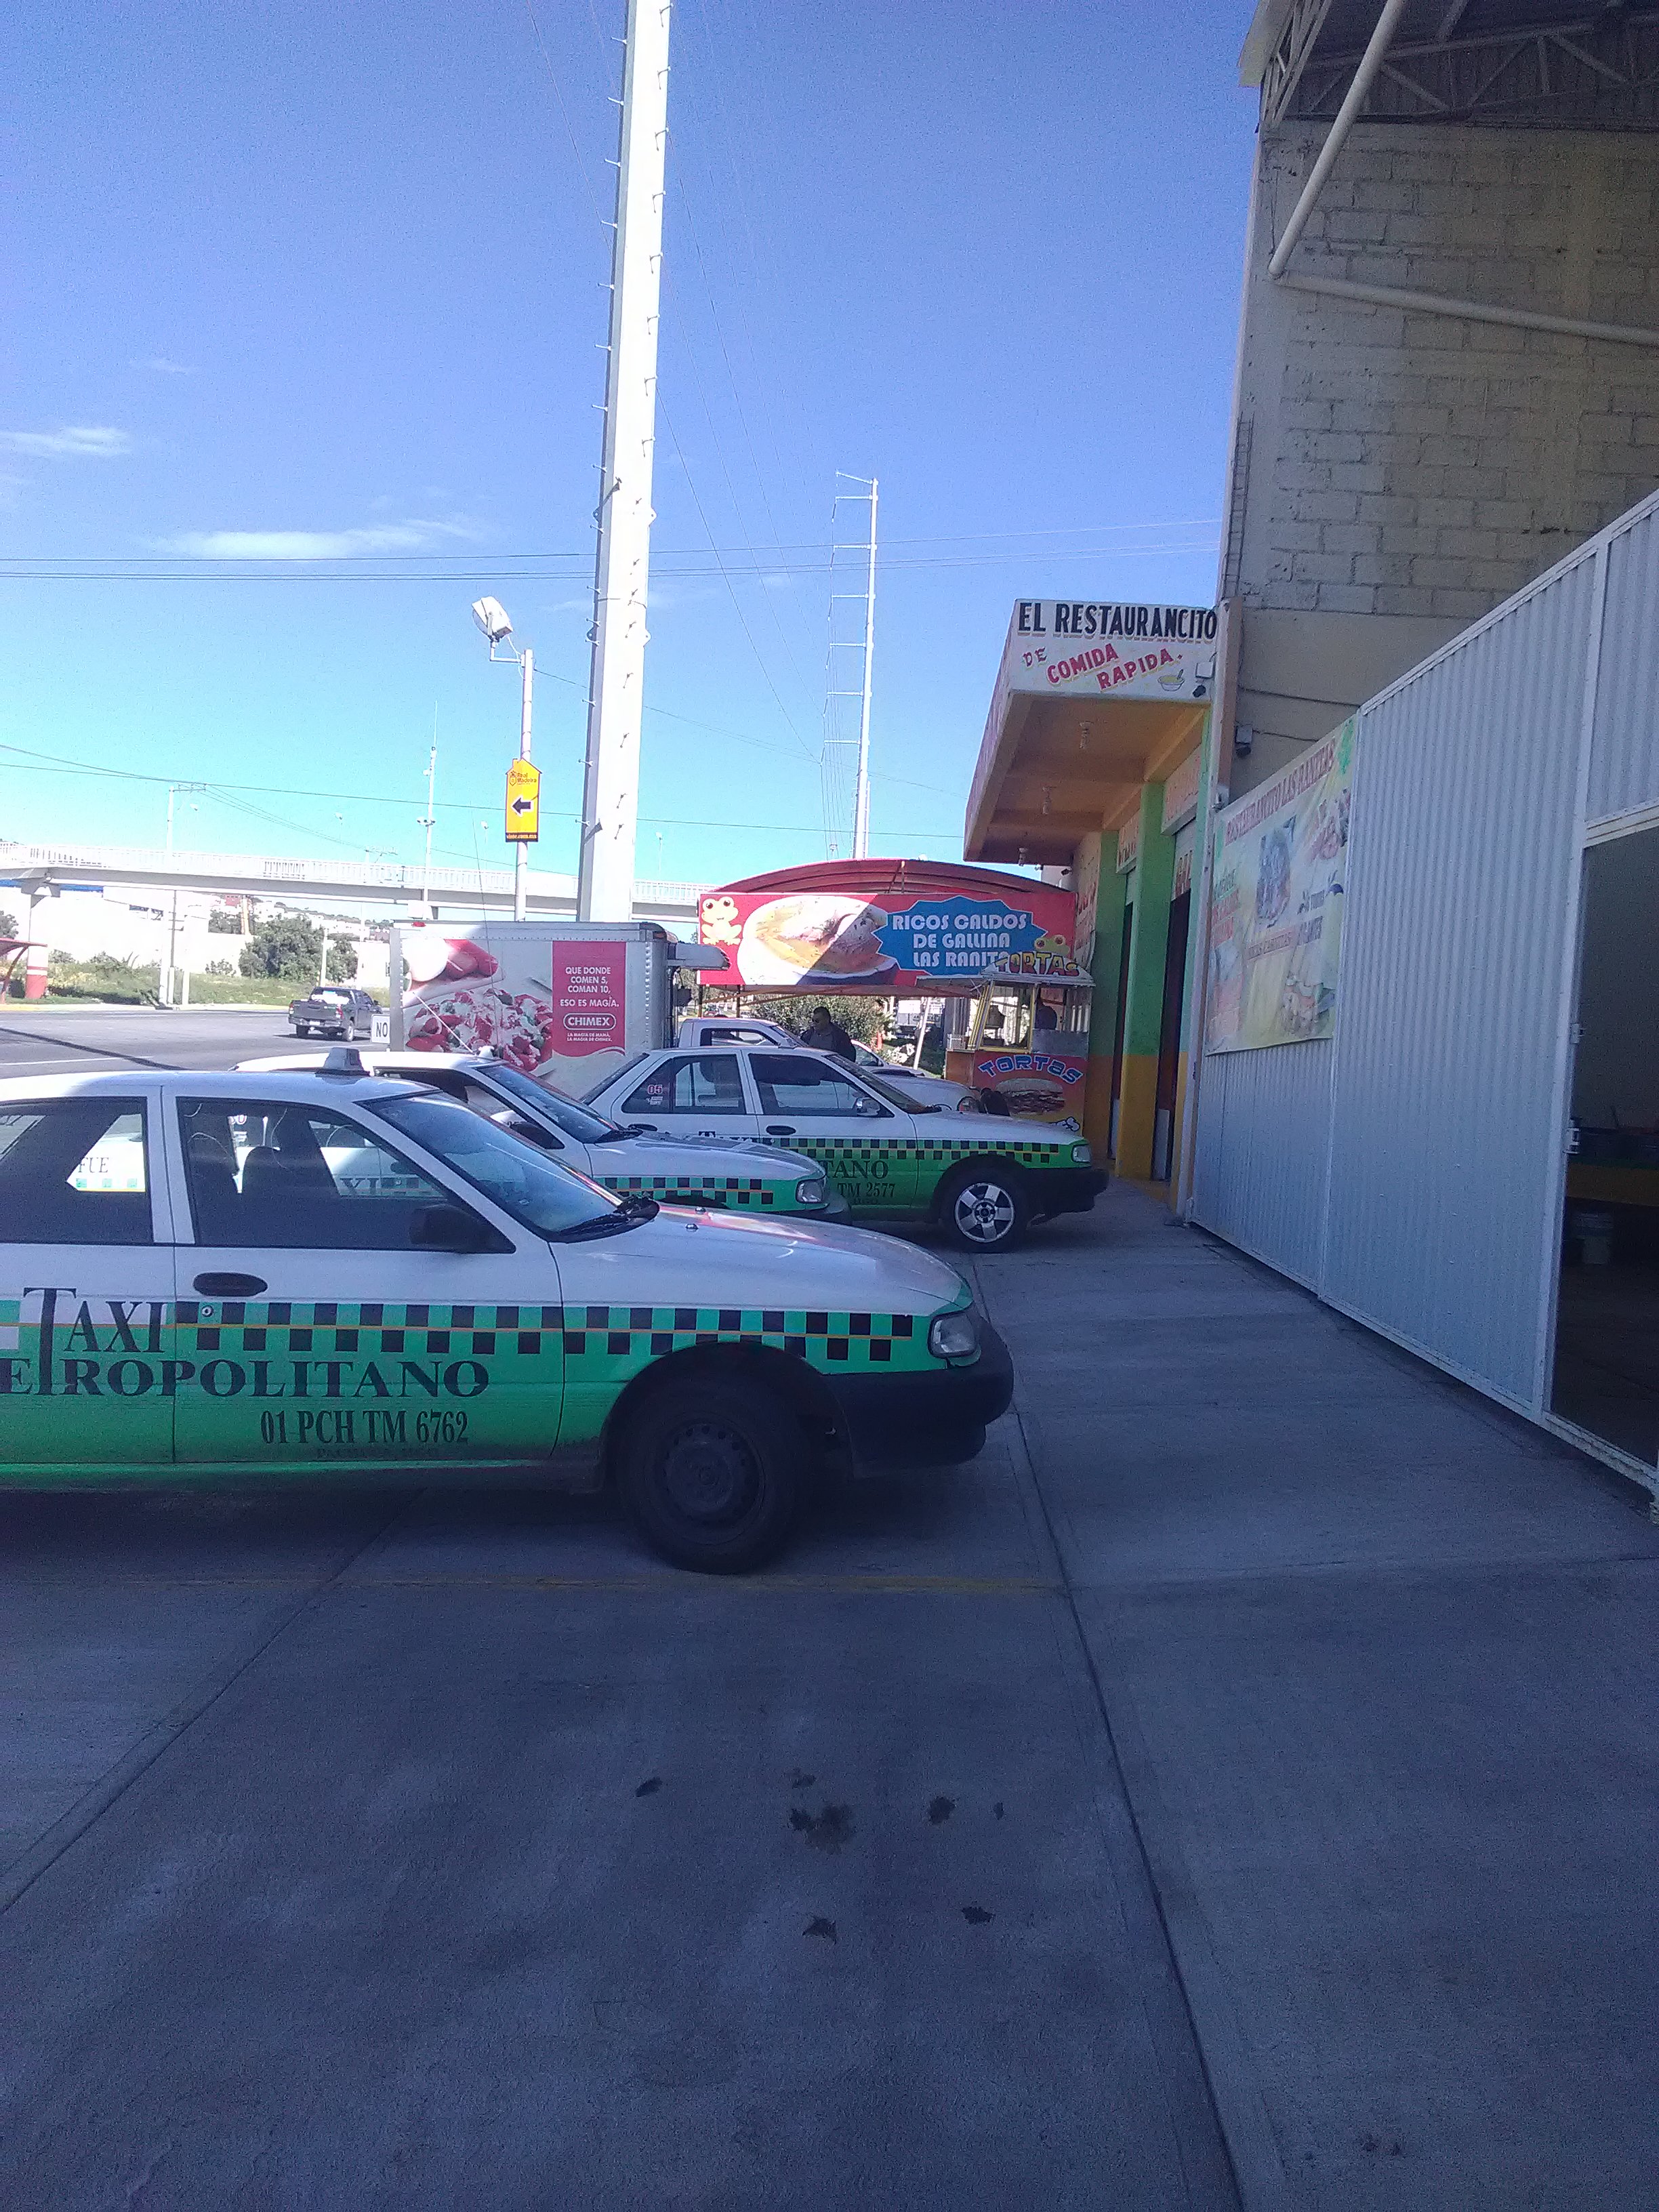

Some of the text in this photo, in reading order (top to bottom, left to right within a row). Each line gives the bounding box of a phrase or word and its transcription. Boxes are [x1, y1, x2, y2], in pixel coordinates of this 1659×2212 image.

[1018, 602, 1218, 640] EL RESTAURANCITO
[1023, 647, 1048, 668] DE
[1046, 643, 1120, 684] COMIDA
[893, 914, 1027, 930] RICOS CALDOS
[914, 933, 1010, 949] DE GALLINA
[913, 951, 941, 968] LAS
[994, 950, 1081, 977] TORTAS
[565, 966, 611, 975] QUE DONDE
[570, 976, 599, 984] COMEN
[567, 985, 598, 994] COMAN
[560, 999, 576, 1007] ESO
[577, 999, 588, 1007] ES
[376, 1022, 388, 1038] NO
[567, 1017, 611, 1027] CHIMEX
[838, 1183, 897, 1197] TM 2577
[23, 1287, 167, 1395] TAXI
[260, 1409, 470, 1444] 01 PCH TM 6762
